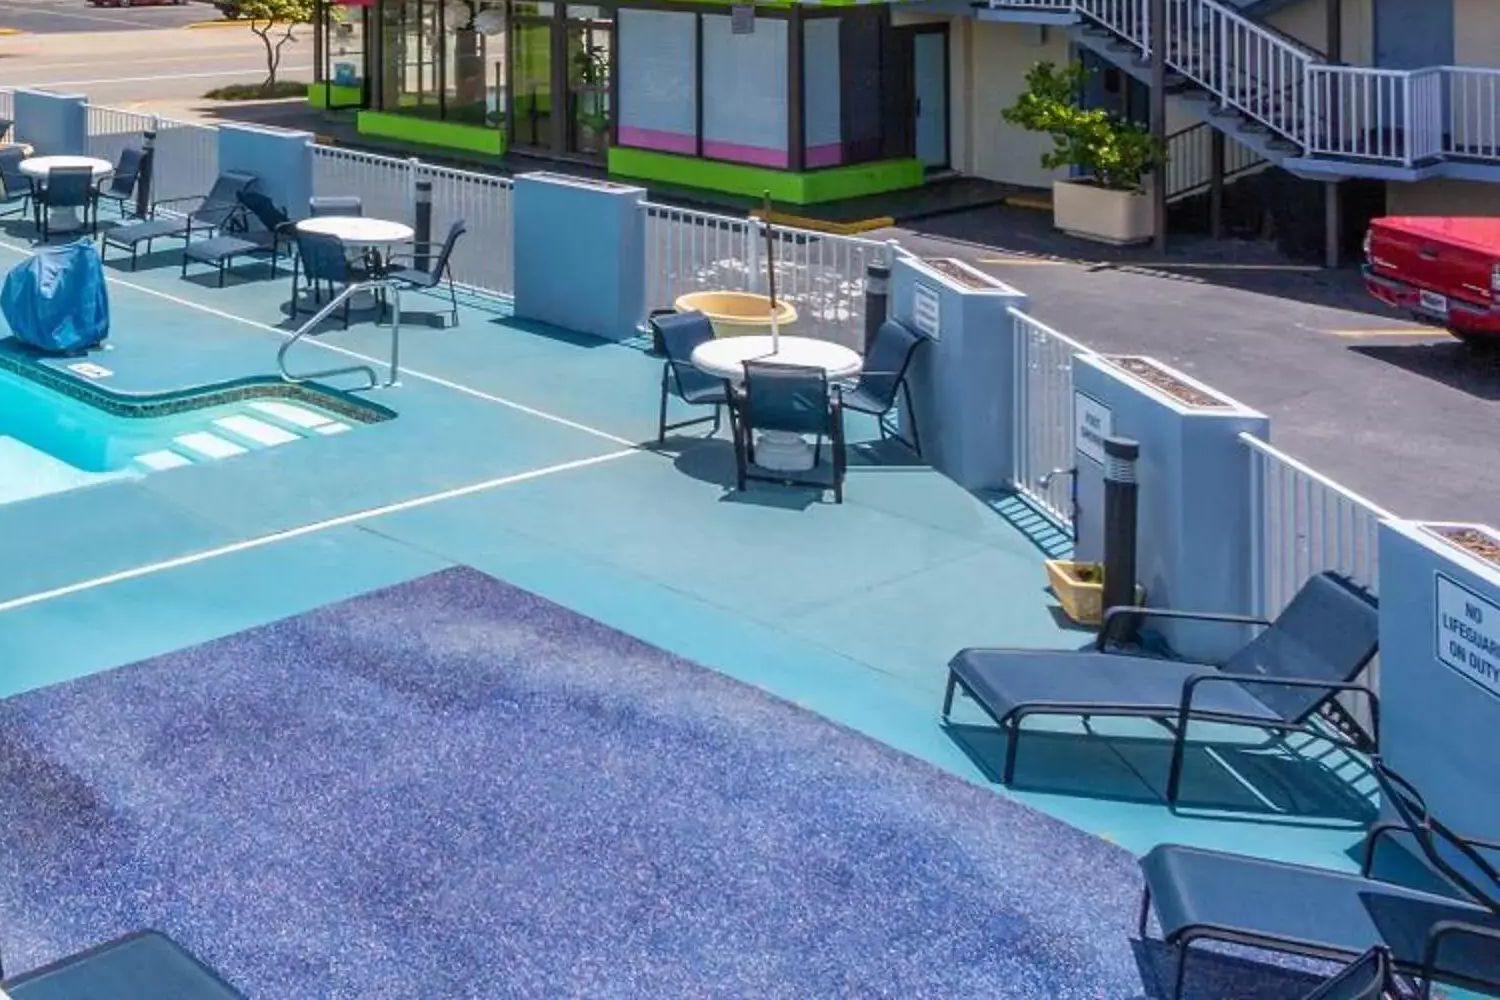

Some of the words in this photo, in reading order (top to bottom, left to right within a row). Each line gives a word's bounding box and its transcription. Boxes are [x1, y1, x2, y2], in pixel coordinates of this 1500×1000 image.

[1464, 601, 1483, 624] NO
[1449, 639, 1467, 664] ON
[1468, 652, 1500, 683] DUTY
